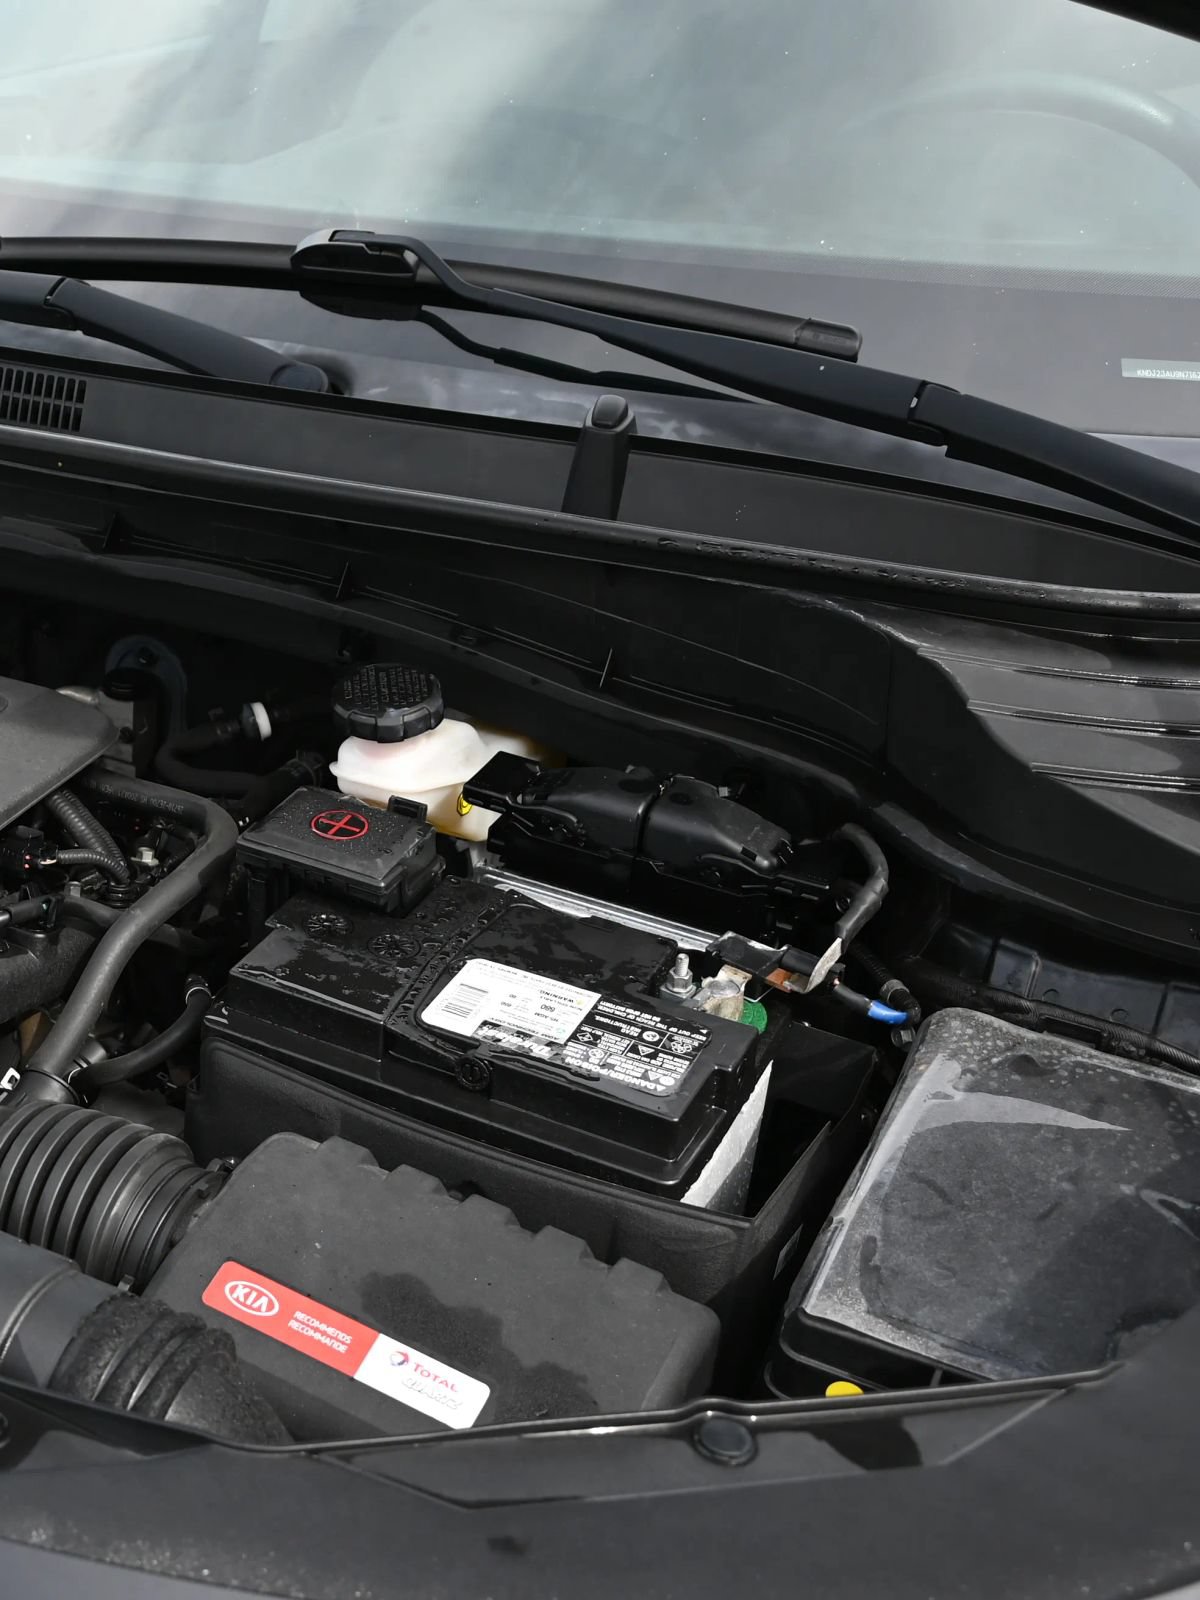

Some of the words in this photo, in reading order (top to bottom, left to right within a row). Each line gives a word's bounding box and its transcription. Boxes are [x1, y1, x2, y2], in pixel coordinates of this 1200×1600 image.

[538, 1003, 556, 1012] 680
[619, 1028, 639, 1036] READ
[231, 1284, 270, 1314] KIA
[287, 1319, 350, 1354] RECOMMANDE
[292, 1310, 353, 1345] RECOMMENDS
[412, 1362, 459, 1393] TOTAL
